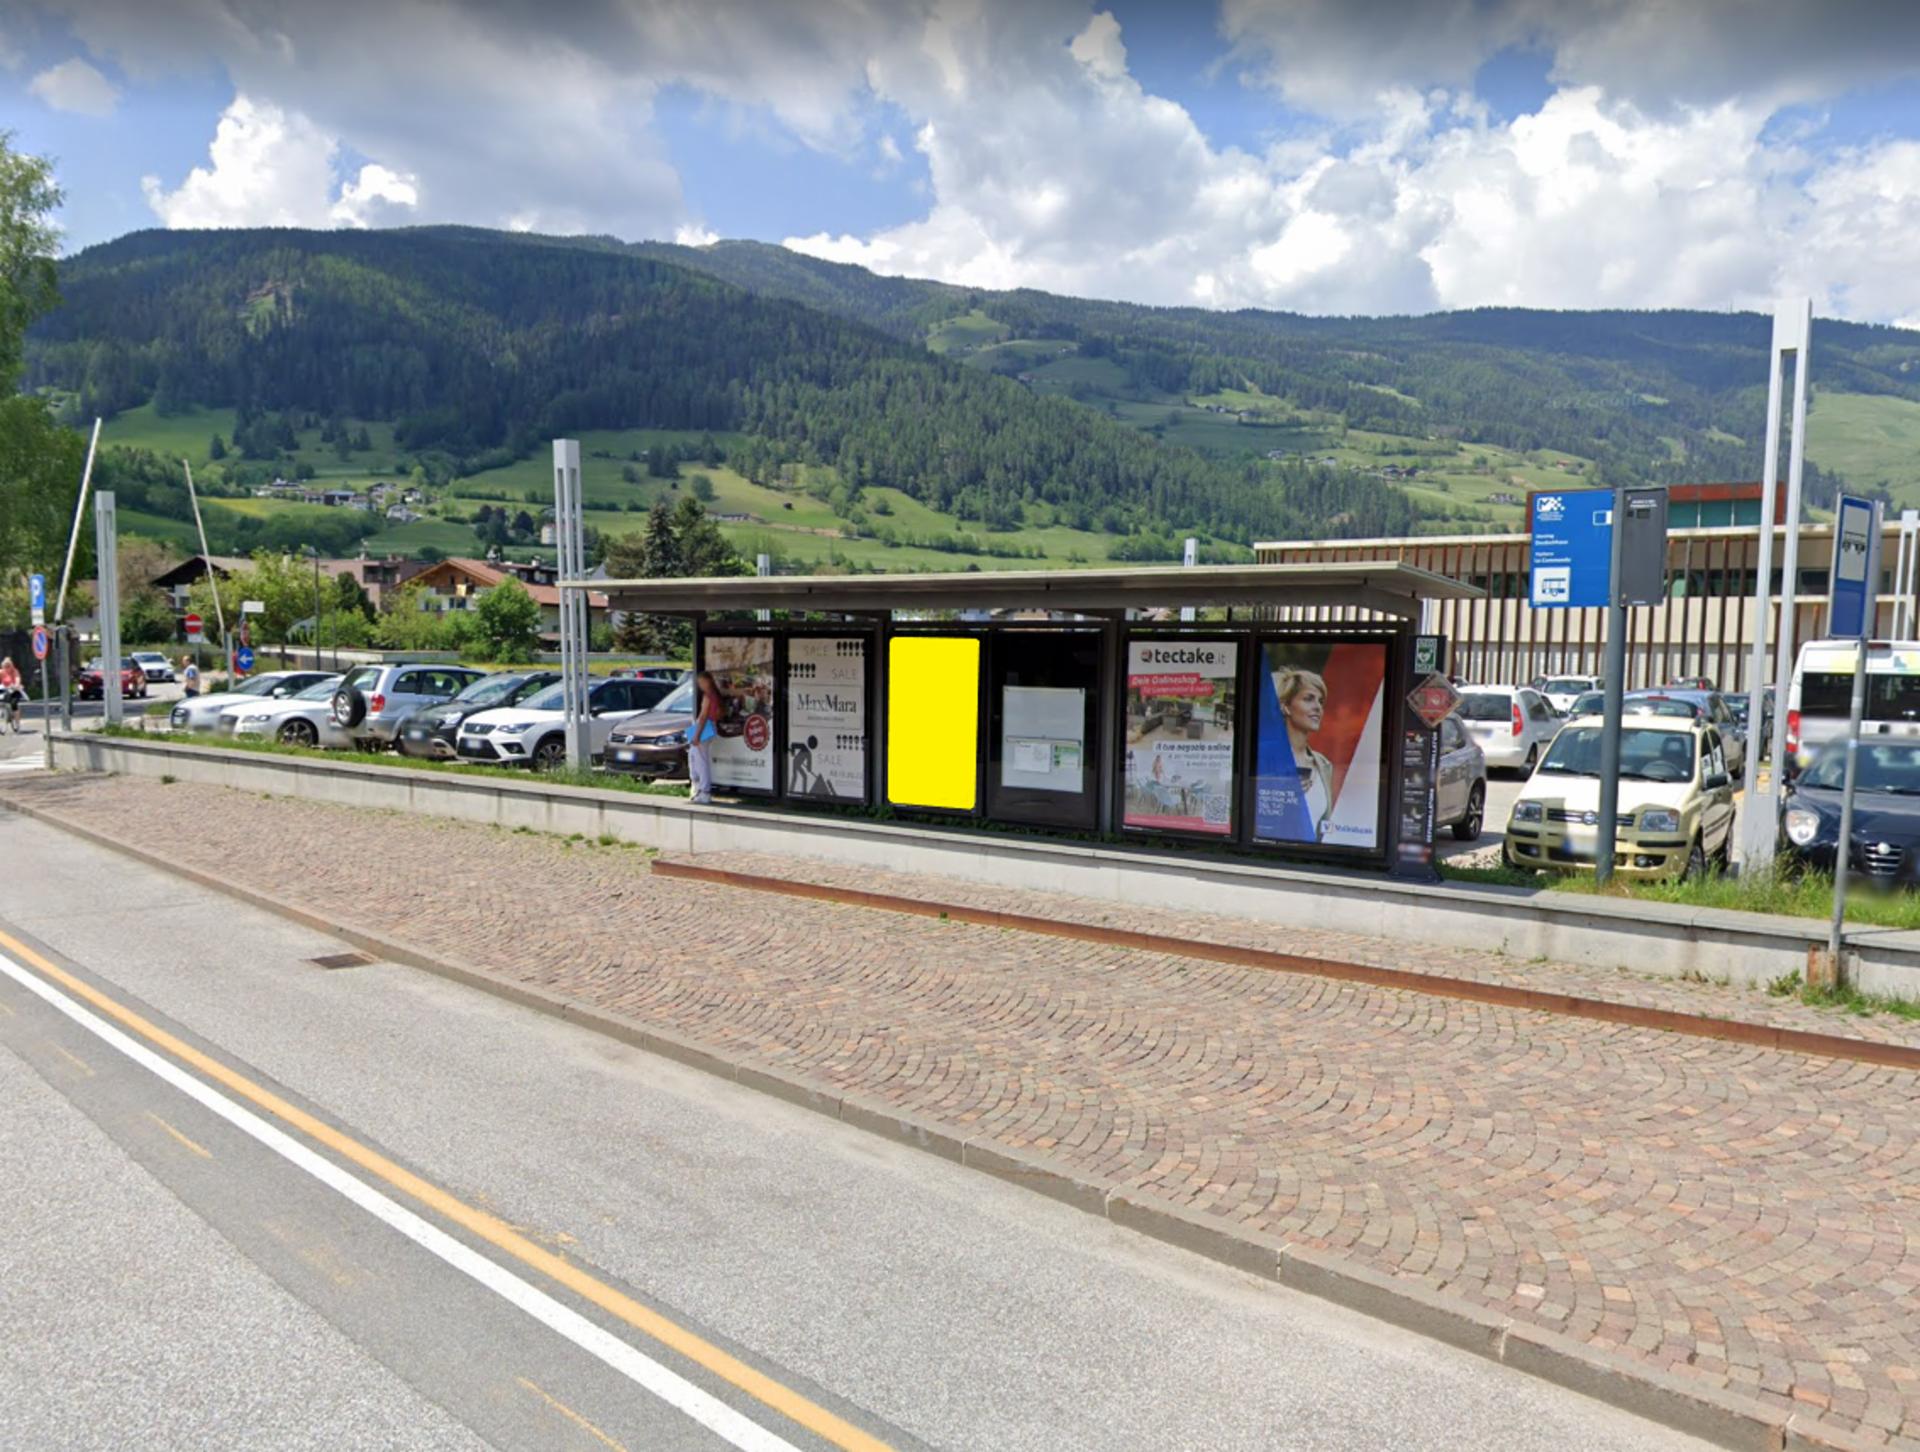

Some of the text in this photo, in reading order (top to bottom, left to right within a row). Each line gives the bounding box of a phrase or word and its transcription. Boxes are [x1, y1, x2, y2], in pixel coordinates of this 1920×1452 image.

[31, 578, 41, 605] P
[803, 645, 828, 656] SALE
[832, 668, 857, 680] SALE
[817, 753, 843, 765] SALE
